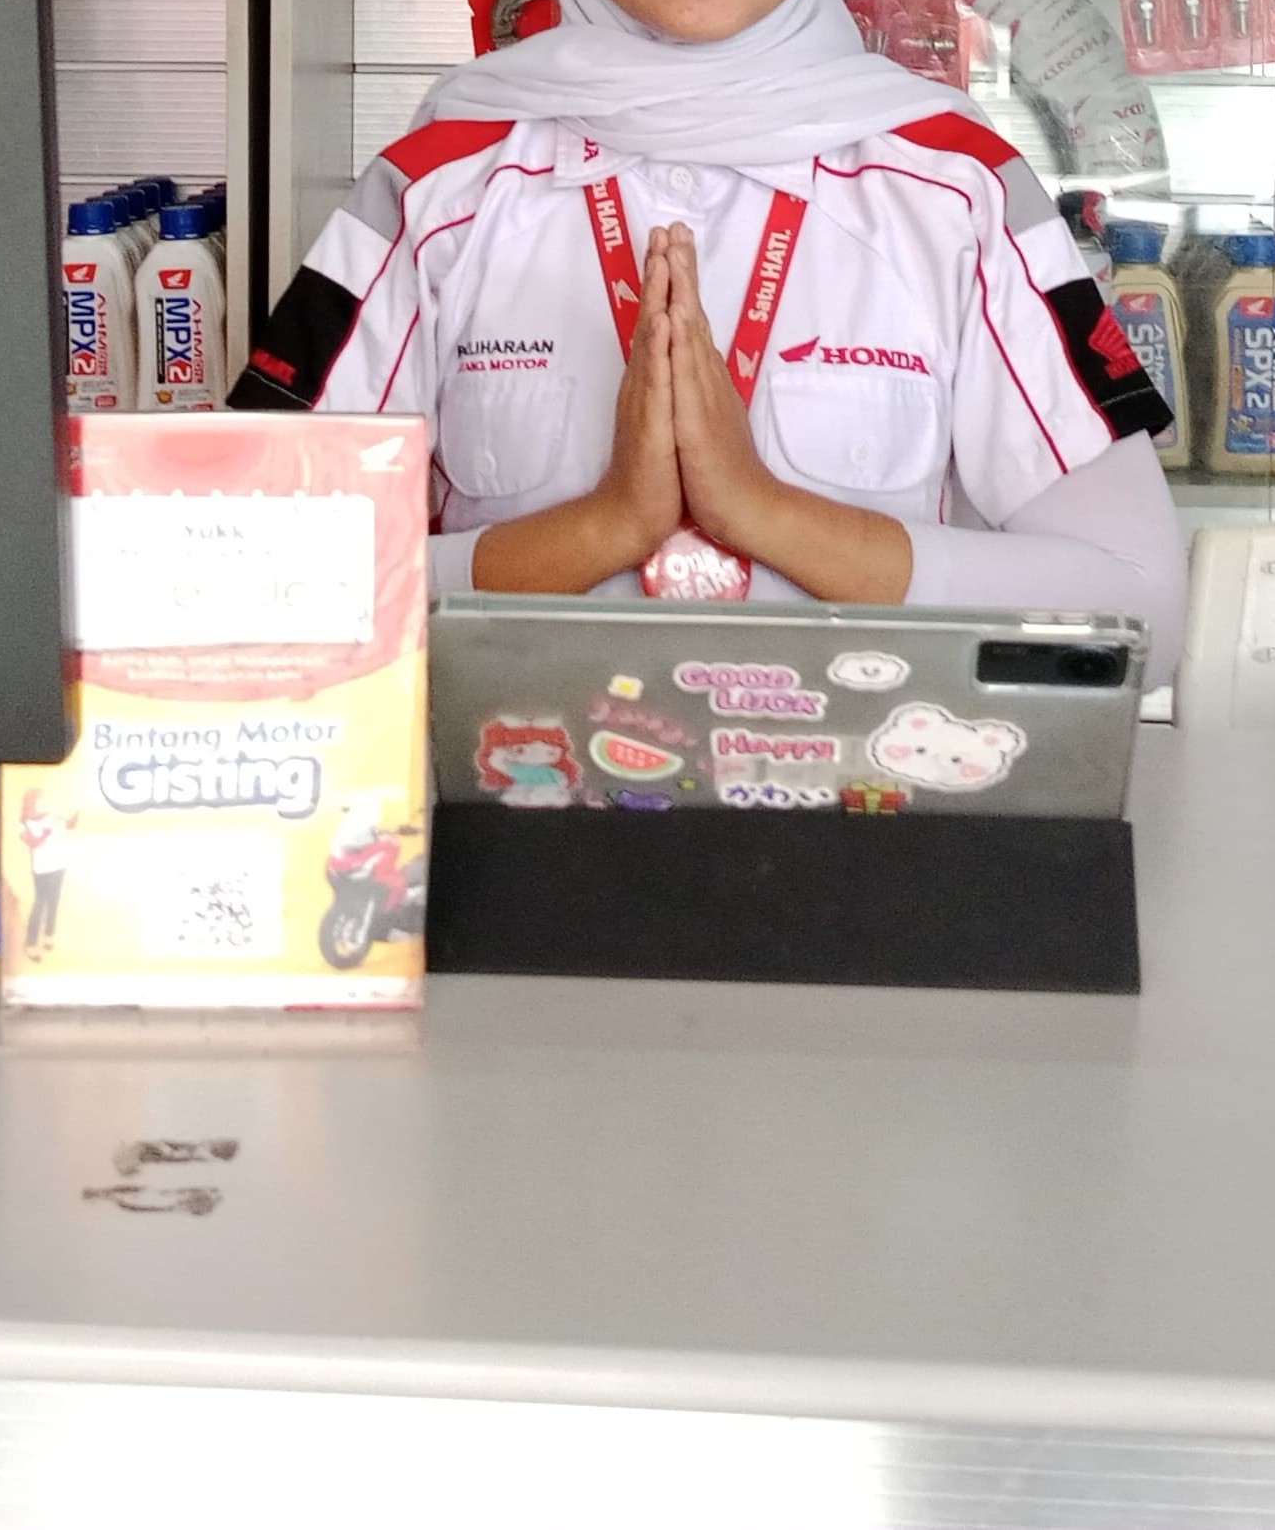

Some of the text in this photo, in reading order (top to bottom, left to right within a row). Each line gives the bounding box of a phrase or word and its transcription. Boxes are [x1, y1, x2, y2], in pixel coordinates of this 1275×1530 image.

[70, 291, 96, 375] MPX2
[165, 298, 192, 383] MPX2
[819, 347, 931, 375] HONDA
[93, 720, 338, 751] Bintang Motor
